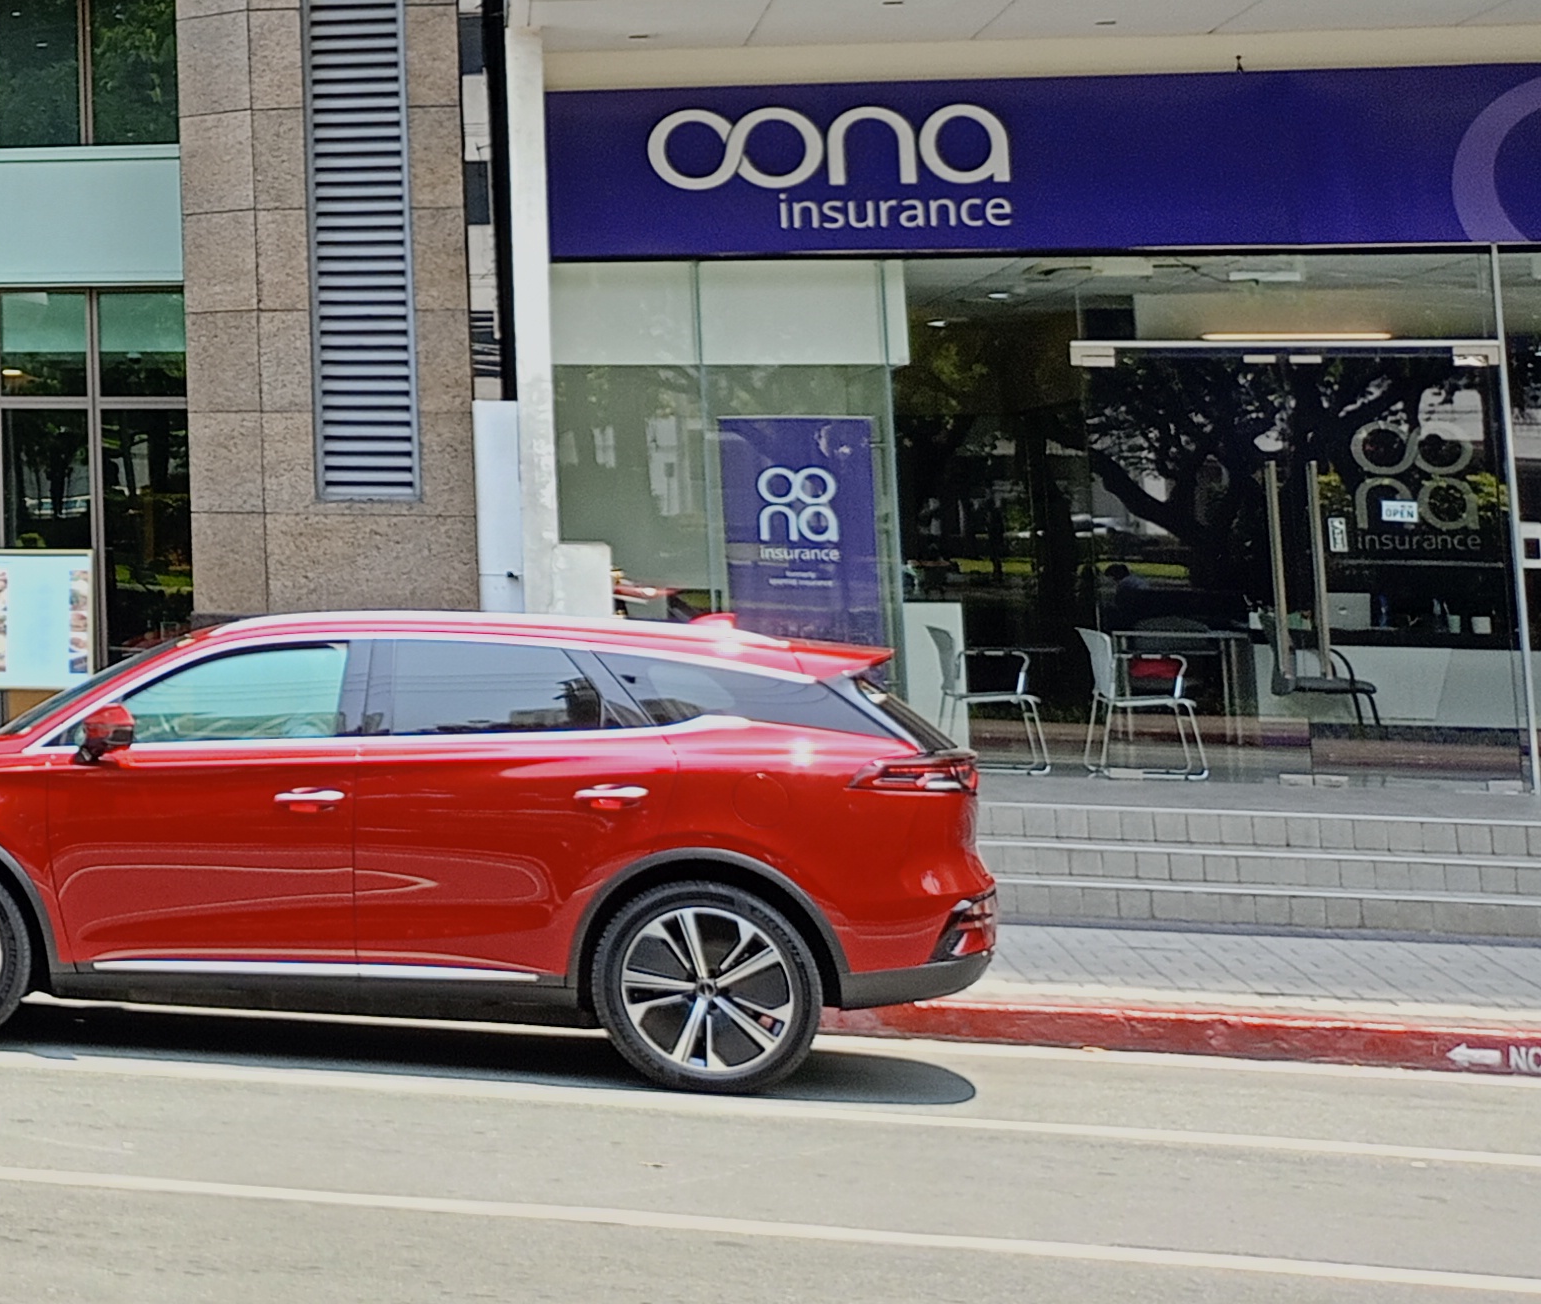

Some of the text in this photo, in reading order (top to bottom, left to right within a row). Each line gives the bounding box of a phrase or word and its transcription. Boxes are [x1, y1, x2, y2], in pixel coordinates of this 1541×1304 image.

[647, 103, 1011, 191] oona
[779, 193, 1012, 229] insurance
[759, 545, 841, 562] insurance
[1358, 533, 1481, 550] insurance
